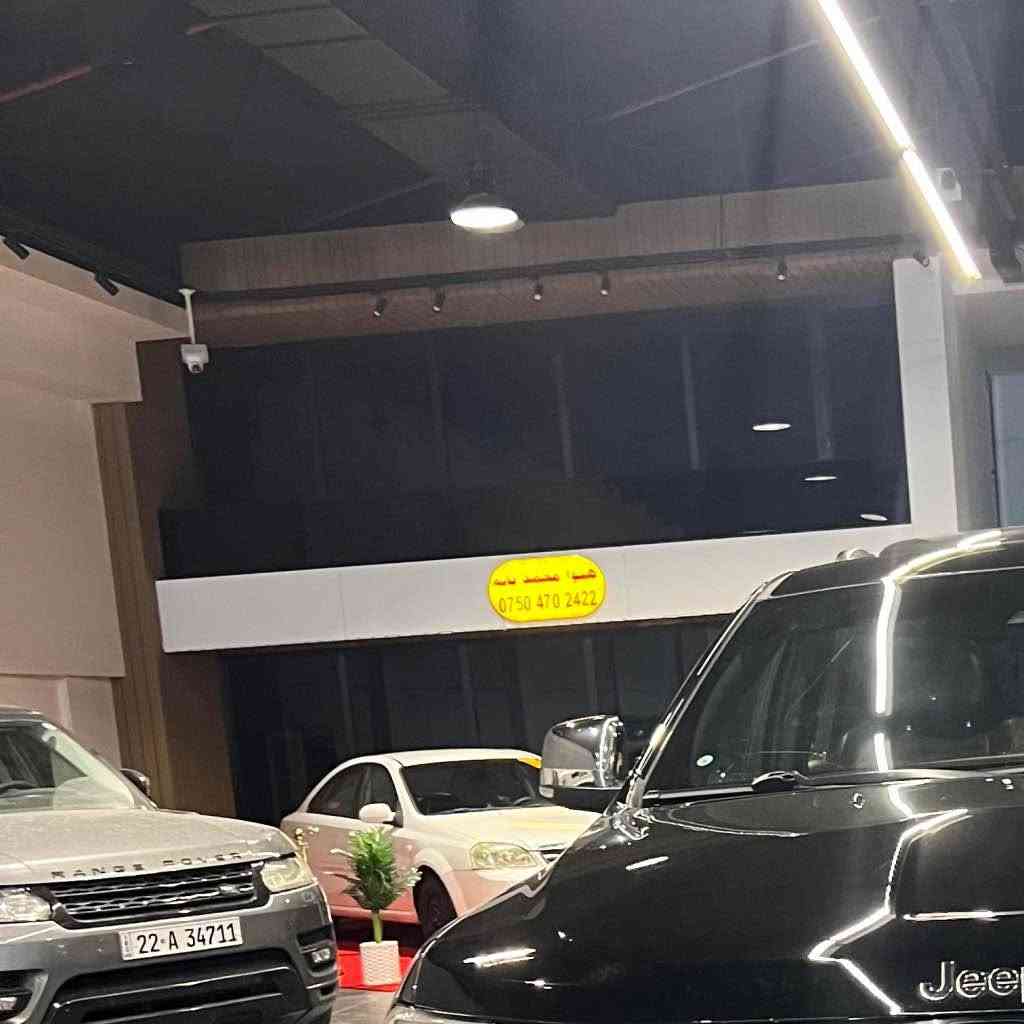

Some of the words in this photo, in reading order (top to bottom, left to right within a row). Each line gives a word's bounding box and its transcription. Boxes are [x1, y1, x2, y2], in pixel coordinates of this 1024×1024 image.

[498, 596, 531, 613] 0750
[536, 593, 560, 609] 470
[565, 590, 598, 608] 2422
[136, 933, 161, 954] 22
[168, 930, 179, 950] A
[184, 923, 238, 947] 34711
